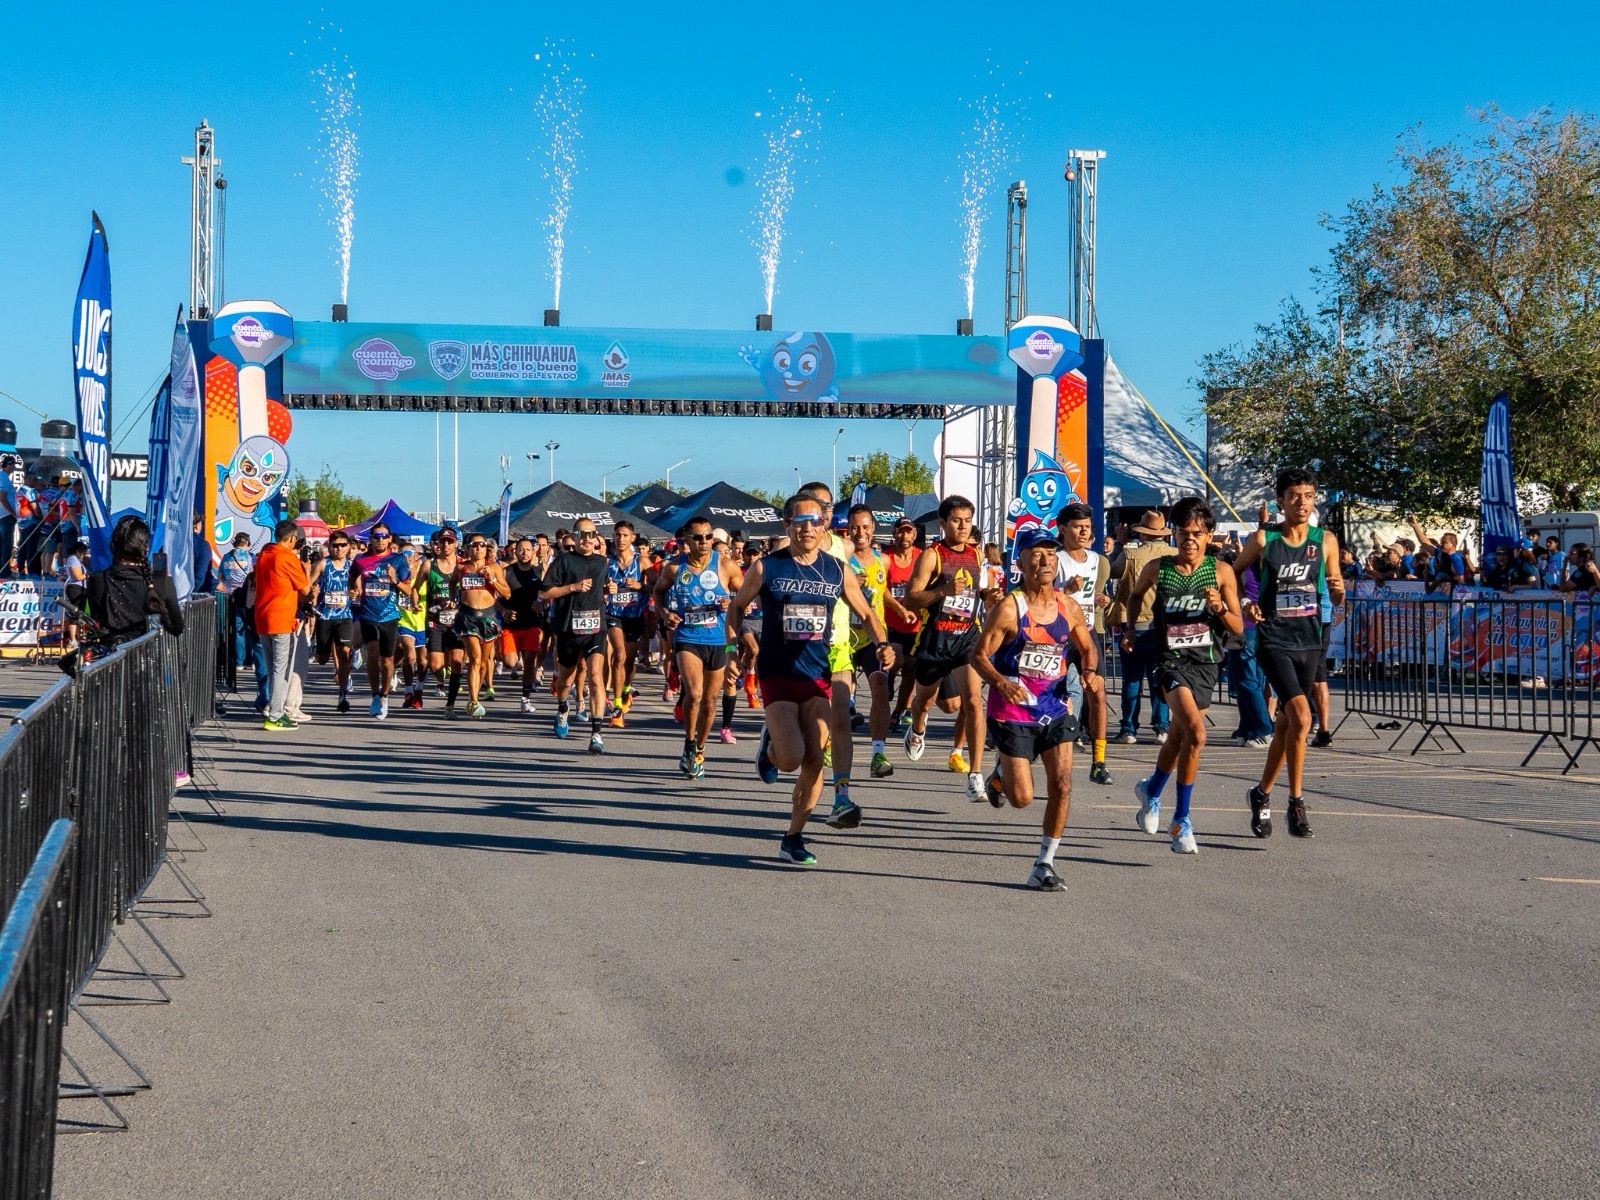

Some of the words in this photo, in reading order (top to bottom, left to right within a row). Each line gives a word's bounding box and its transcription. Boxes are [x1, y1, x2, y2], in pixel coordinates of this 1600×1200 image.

[239, 330, 273, 340] conmigo
[471, 342, 500, 361] MÁS
[503, 345, 577, 362] CHIHUAHUA
[1031, 344, 1062, 352] conmigo
[355, 350, 398, 359] cuenta
[363, 357, 413, 368] conmigo
[471, 361, 498, 370] más
[502, 361, 518, 371] de
[522, 361, 533, 371] lo
[537, 362, 577, 371] bueno
[602, 373, 631, 381] JMAS
[546, 510, 612, 520] POWER
[709, 506, 776, 517] POWER
[1278, 562, 1311, 581] UTCJ
[770, 578, 841, 597] STARTER
[616, 593, 634, 601] 889
[1284, 595, 1310, 607] 135
[1165, 595, 1207, 617] UTCJ
[574, 618, 600, 628] 1439
[686, 612, 716, 623] 1315
[786, 618, 823, 631] 1685
[1023, 653, 1060, 671] 1975
